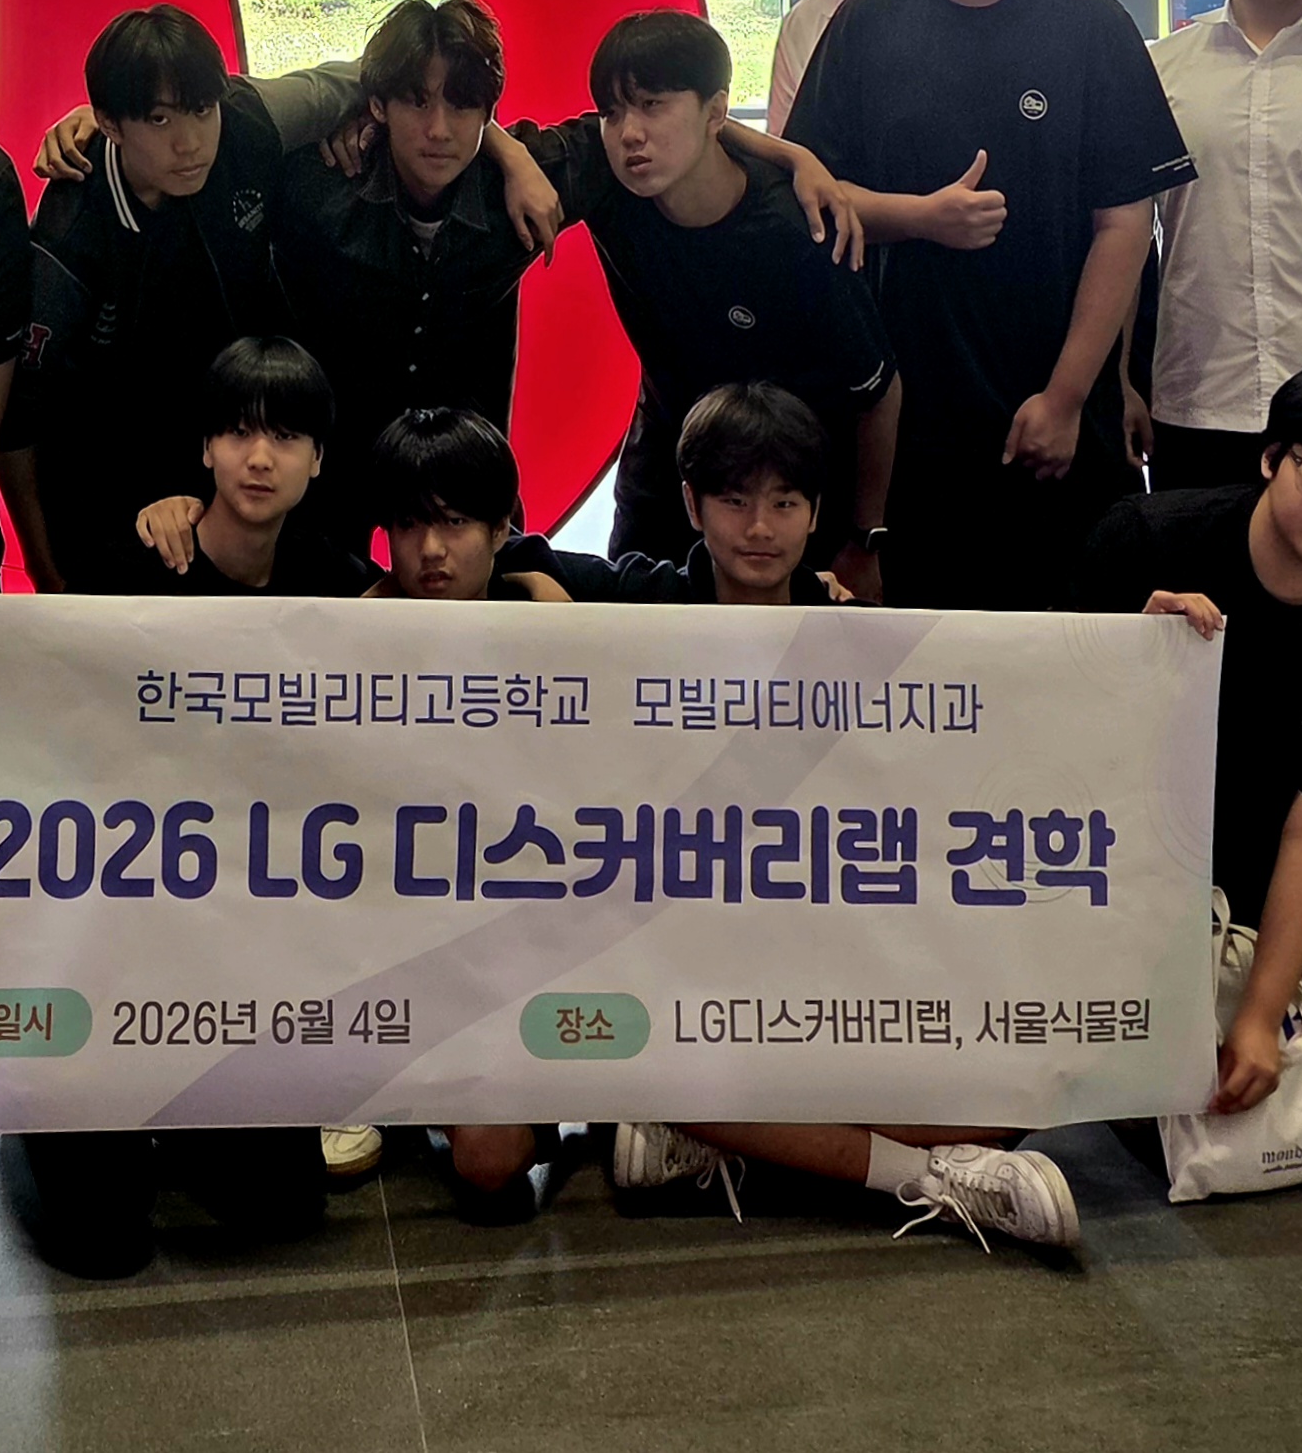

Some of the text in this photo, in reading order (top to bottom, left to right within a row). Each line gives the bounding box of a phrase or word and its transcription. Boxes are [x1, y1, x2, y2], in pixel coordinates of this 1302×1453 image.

[136, 668, 984, 735] 한국모빌리티고등학교 모빌리티에너지과
[248, 800, 364, 901] LG
[395, 801, 919, 906] 디스커버리랩
[946, 808, 1117, 907] 견학
[112, 999, 258, 1046] 2026년
[271, 998, 335, 1045] 6월
[347, 998, 412, 1045] 4일
[555, 997, 1151, 1051] 장소 LG디스커버리랩, 서울식물원
